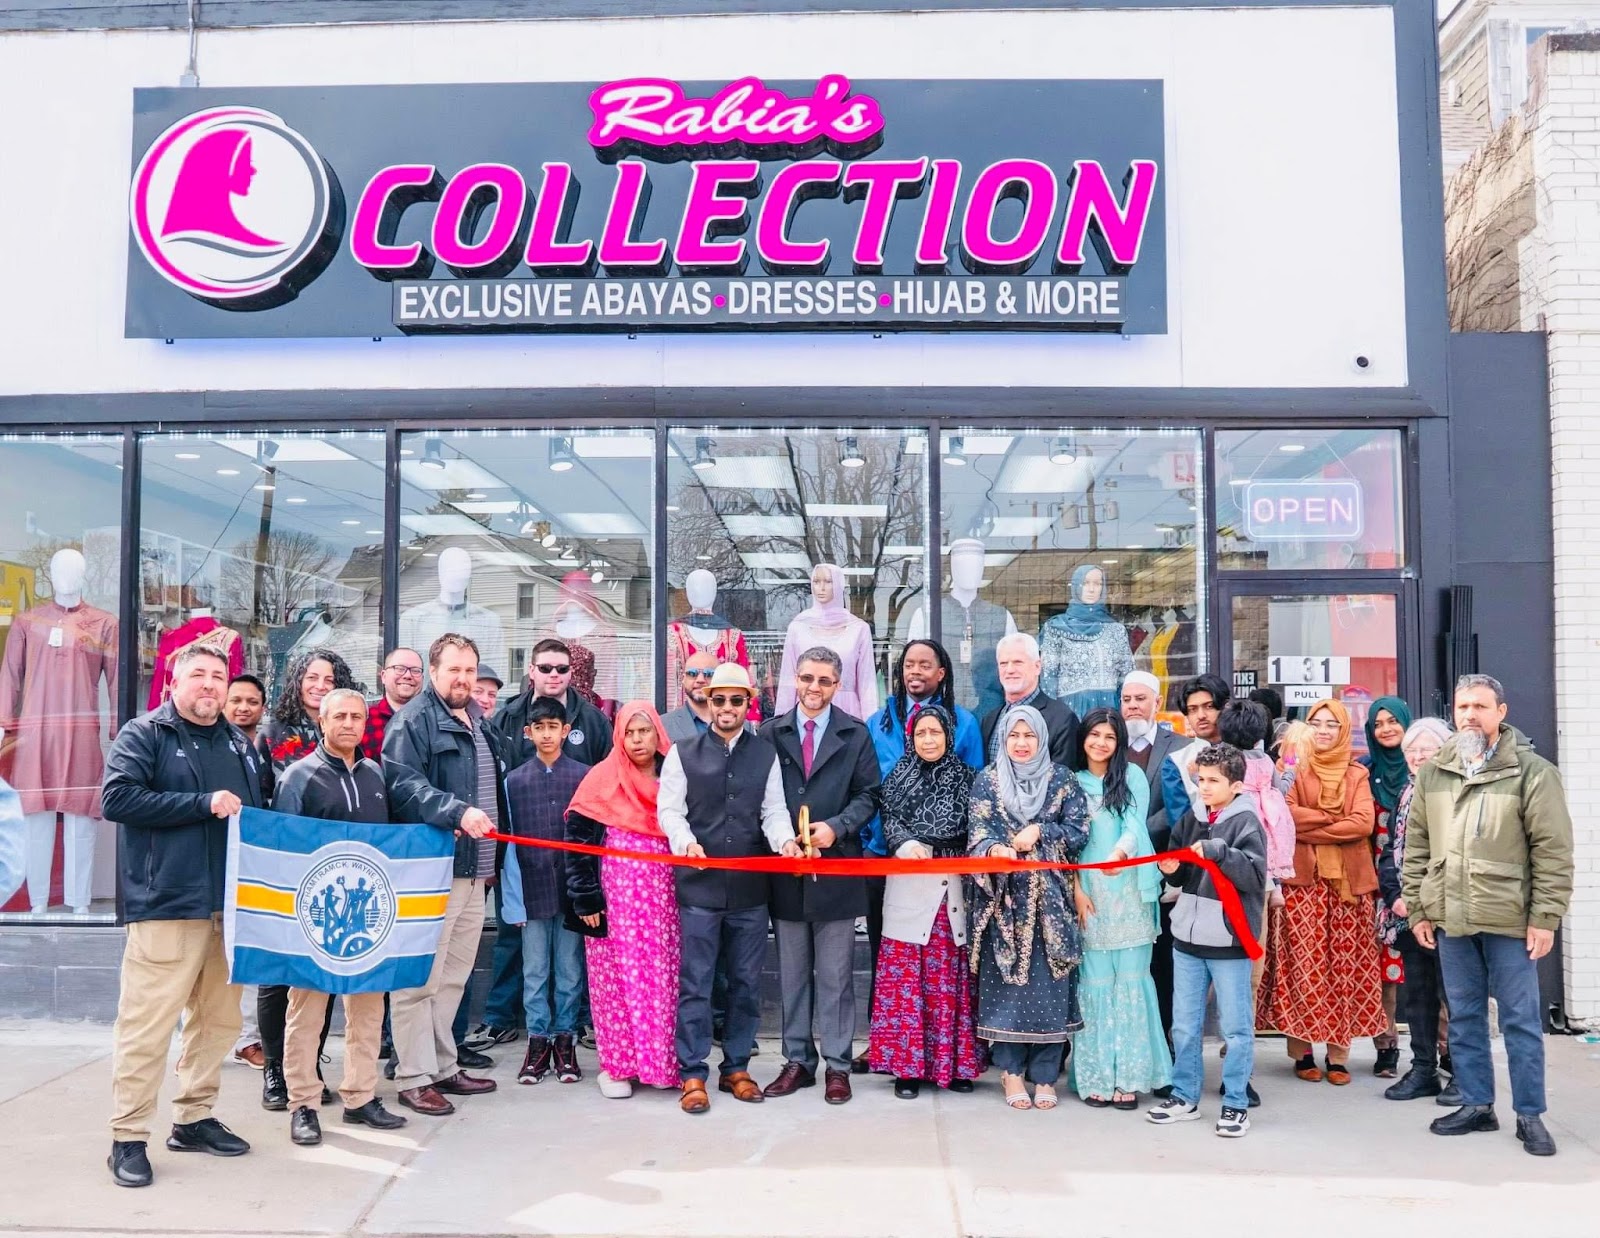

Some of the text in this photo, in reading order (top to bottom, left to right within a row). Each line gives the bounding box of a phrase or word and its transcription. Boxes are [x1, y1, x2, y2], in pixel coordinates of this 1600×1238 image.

[599, 82, 872, 138] Rabia's
[351, 157, 1158, 268] COLLECTION
[400, 281, 1120, 319] EXCLUSIVE ABAYAS DRESSES HIJAB & MORE
[1253, 497, 1353, 523] OPEN
[1294, 691, 1320, 699] PULL
[304, 914, 315, 932] CITY
[351, 861, 377, 879] WAYNE
[373, 893, 389, 935] MICHIGAN
